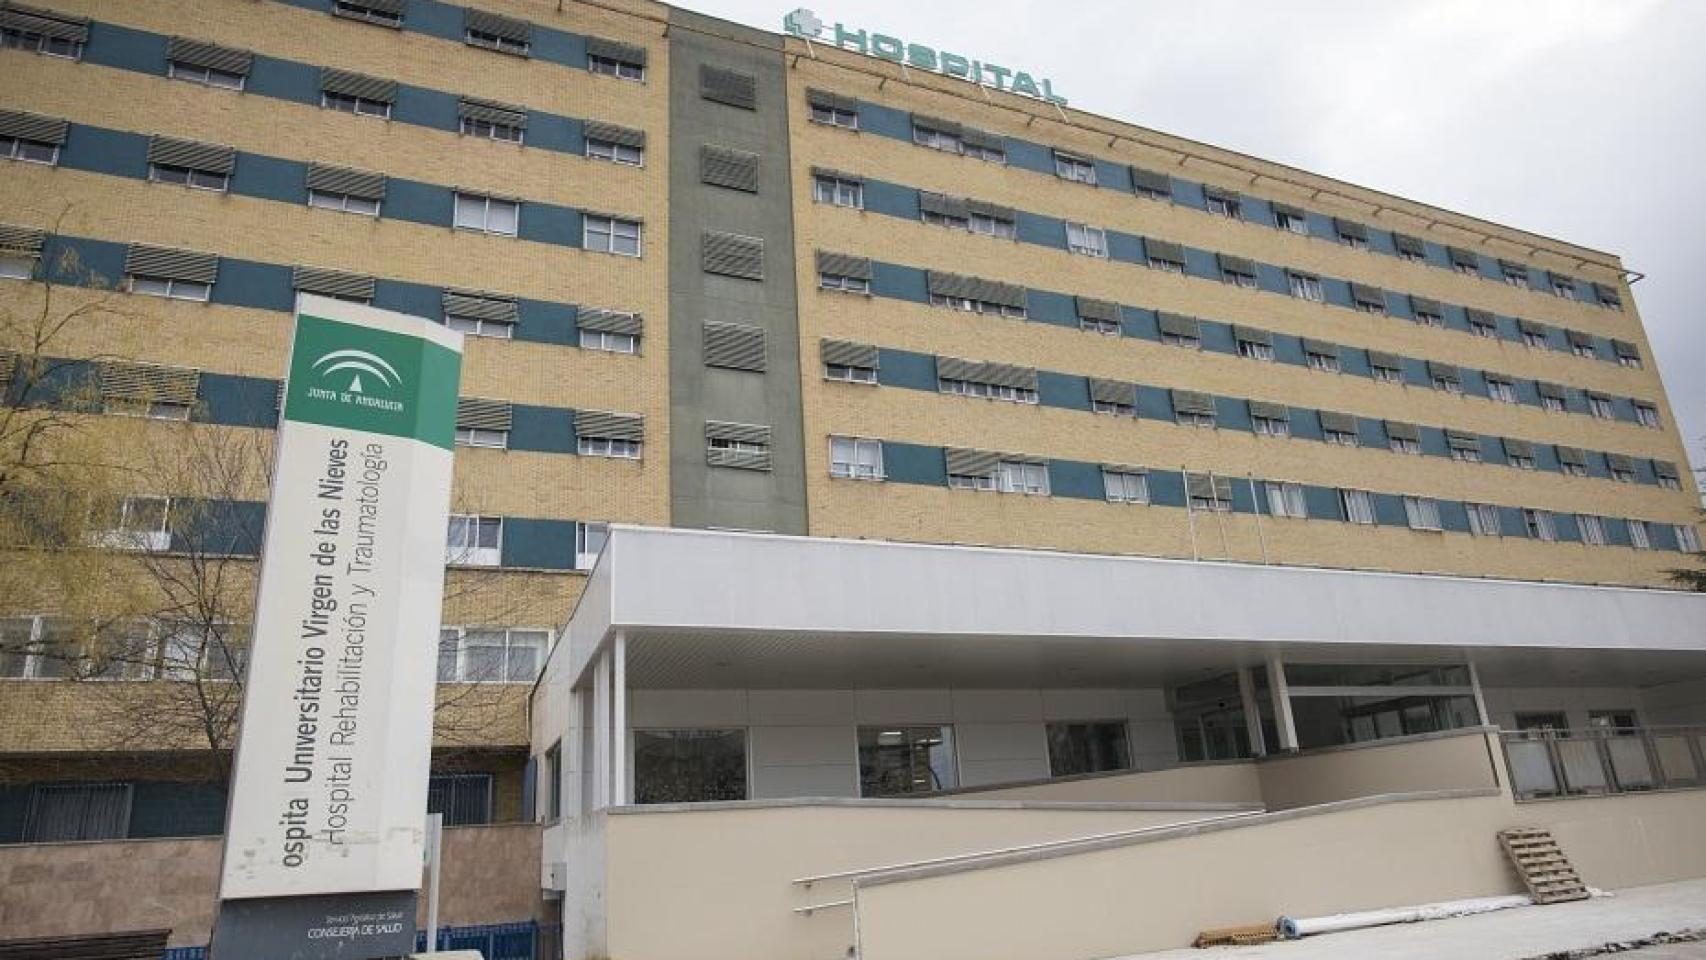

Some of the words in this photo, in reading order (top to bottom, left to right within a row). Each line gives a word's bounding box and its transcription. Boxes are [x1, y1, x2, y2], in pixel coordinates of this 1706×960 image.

[835, 23, 1068, 105] HOSPITAL
[308, 387, 336, 400] JUNTA
[341, 392, 352, 402] DE
[318, 439, 349, 500] Nieves
[314, 508, 340, 535] las
[347, 443, 387, 576] Traumatología
[310, 542, 336, 566] de
[302, 574, 337, 639] Virgen
[351, 583, 375, 597] y
[330, 603, 367, 745] Rehabilitación
[284, 647, 325, 782] Universitario
[321, 757, 355, 845] Hospital
[361, 924, 373, 935] DE
[376, 922, 403, 934] SALUD
